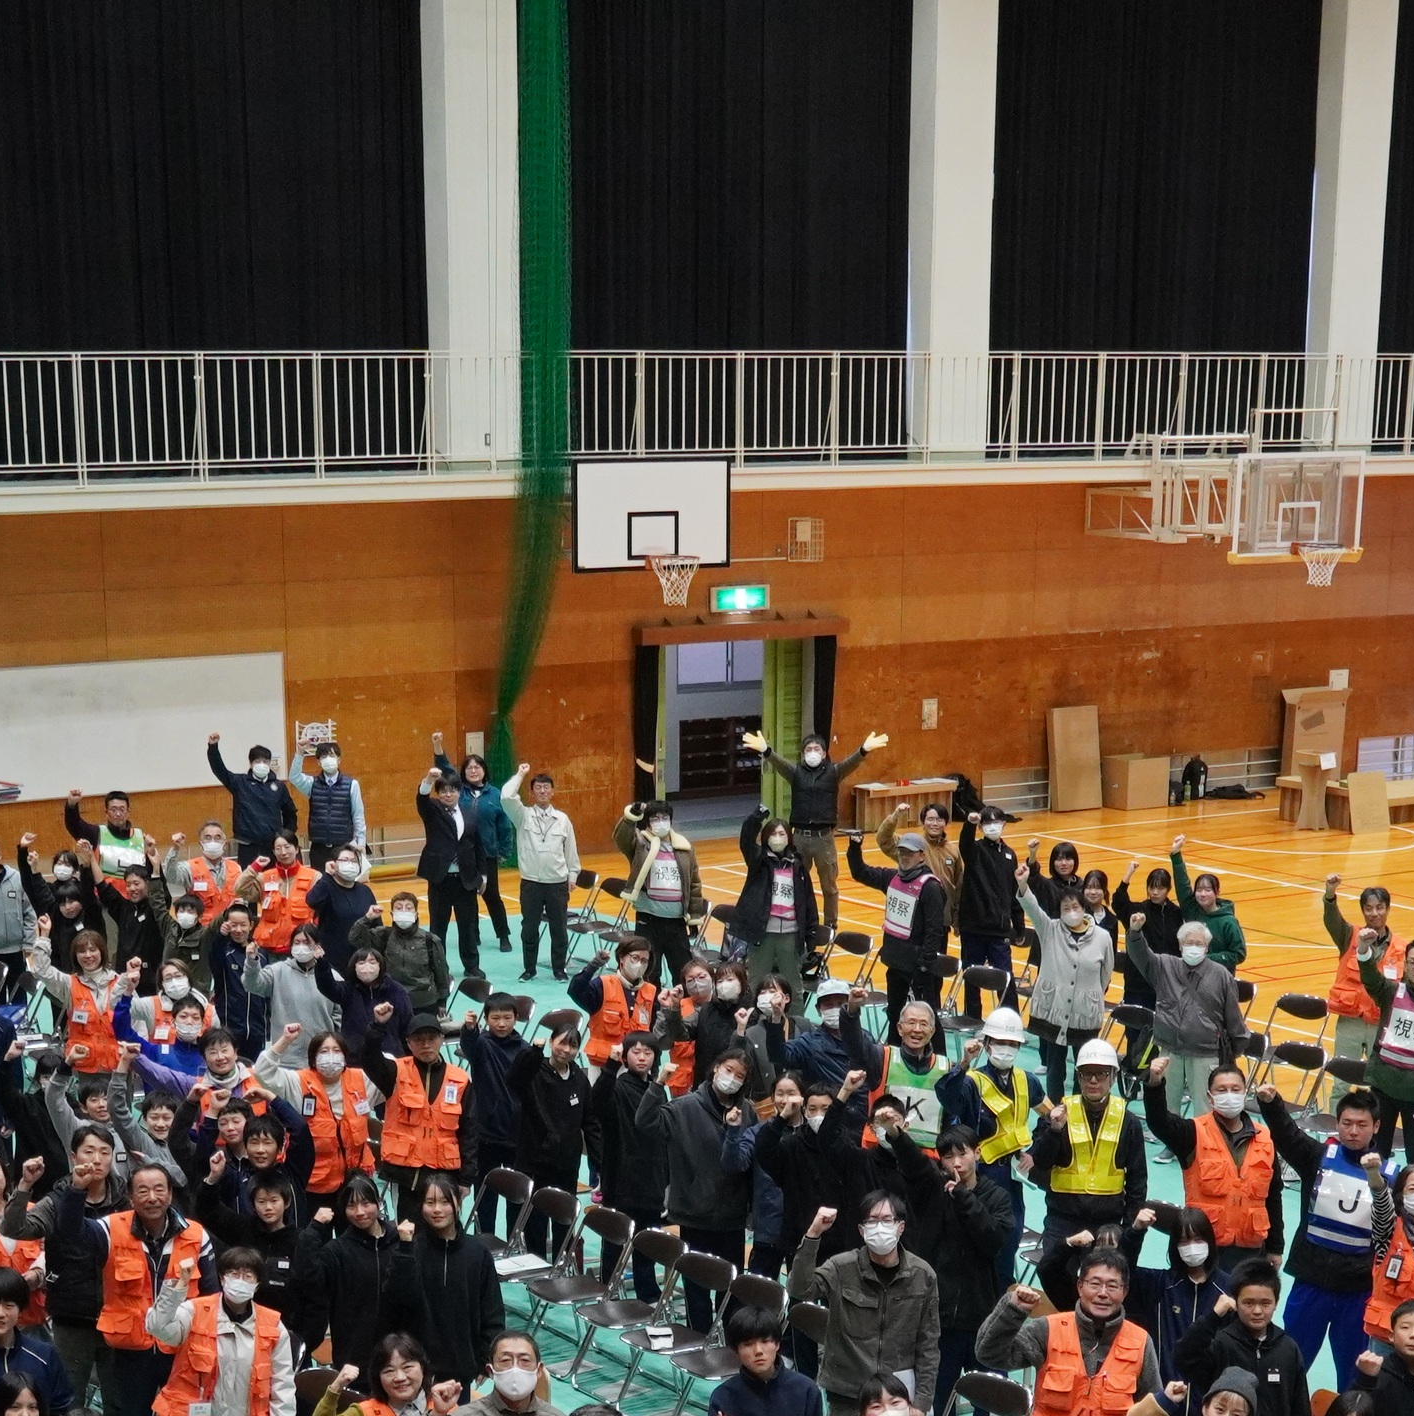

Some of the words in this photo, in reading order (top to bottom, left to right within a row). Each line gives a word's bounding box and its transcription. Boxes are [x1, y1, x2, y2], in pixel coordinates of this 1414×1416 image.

[888, 894, 911, 917] 視察
[906, 1095, 927, 1121] K
[1338, 1189, 1362, 1213] J
